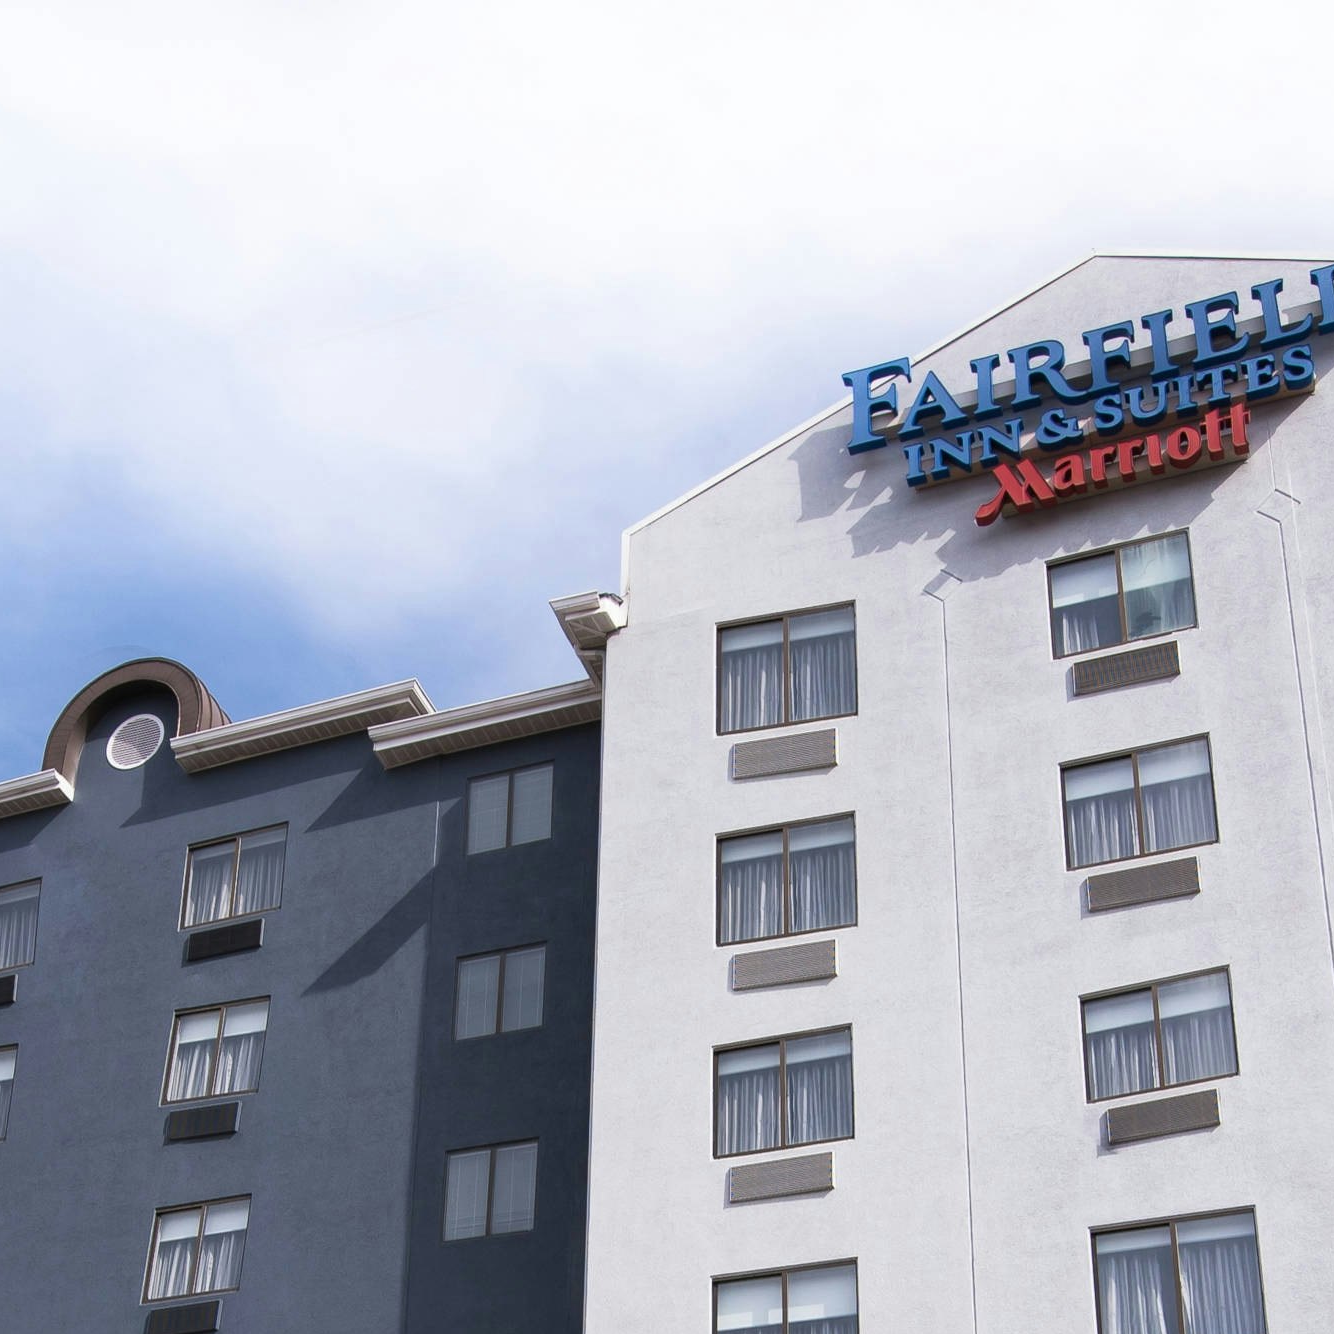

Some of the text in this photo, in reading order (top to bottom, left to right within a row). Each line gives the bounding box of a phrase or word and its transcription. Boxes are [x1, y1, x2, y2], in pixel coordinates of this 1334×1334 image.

[903, 344, 1315, 487] INN & SUITES
[974, 402, 1251, 527] Marriott
